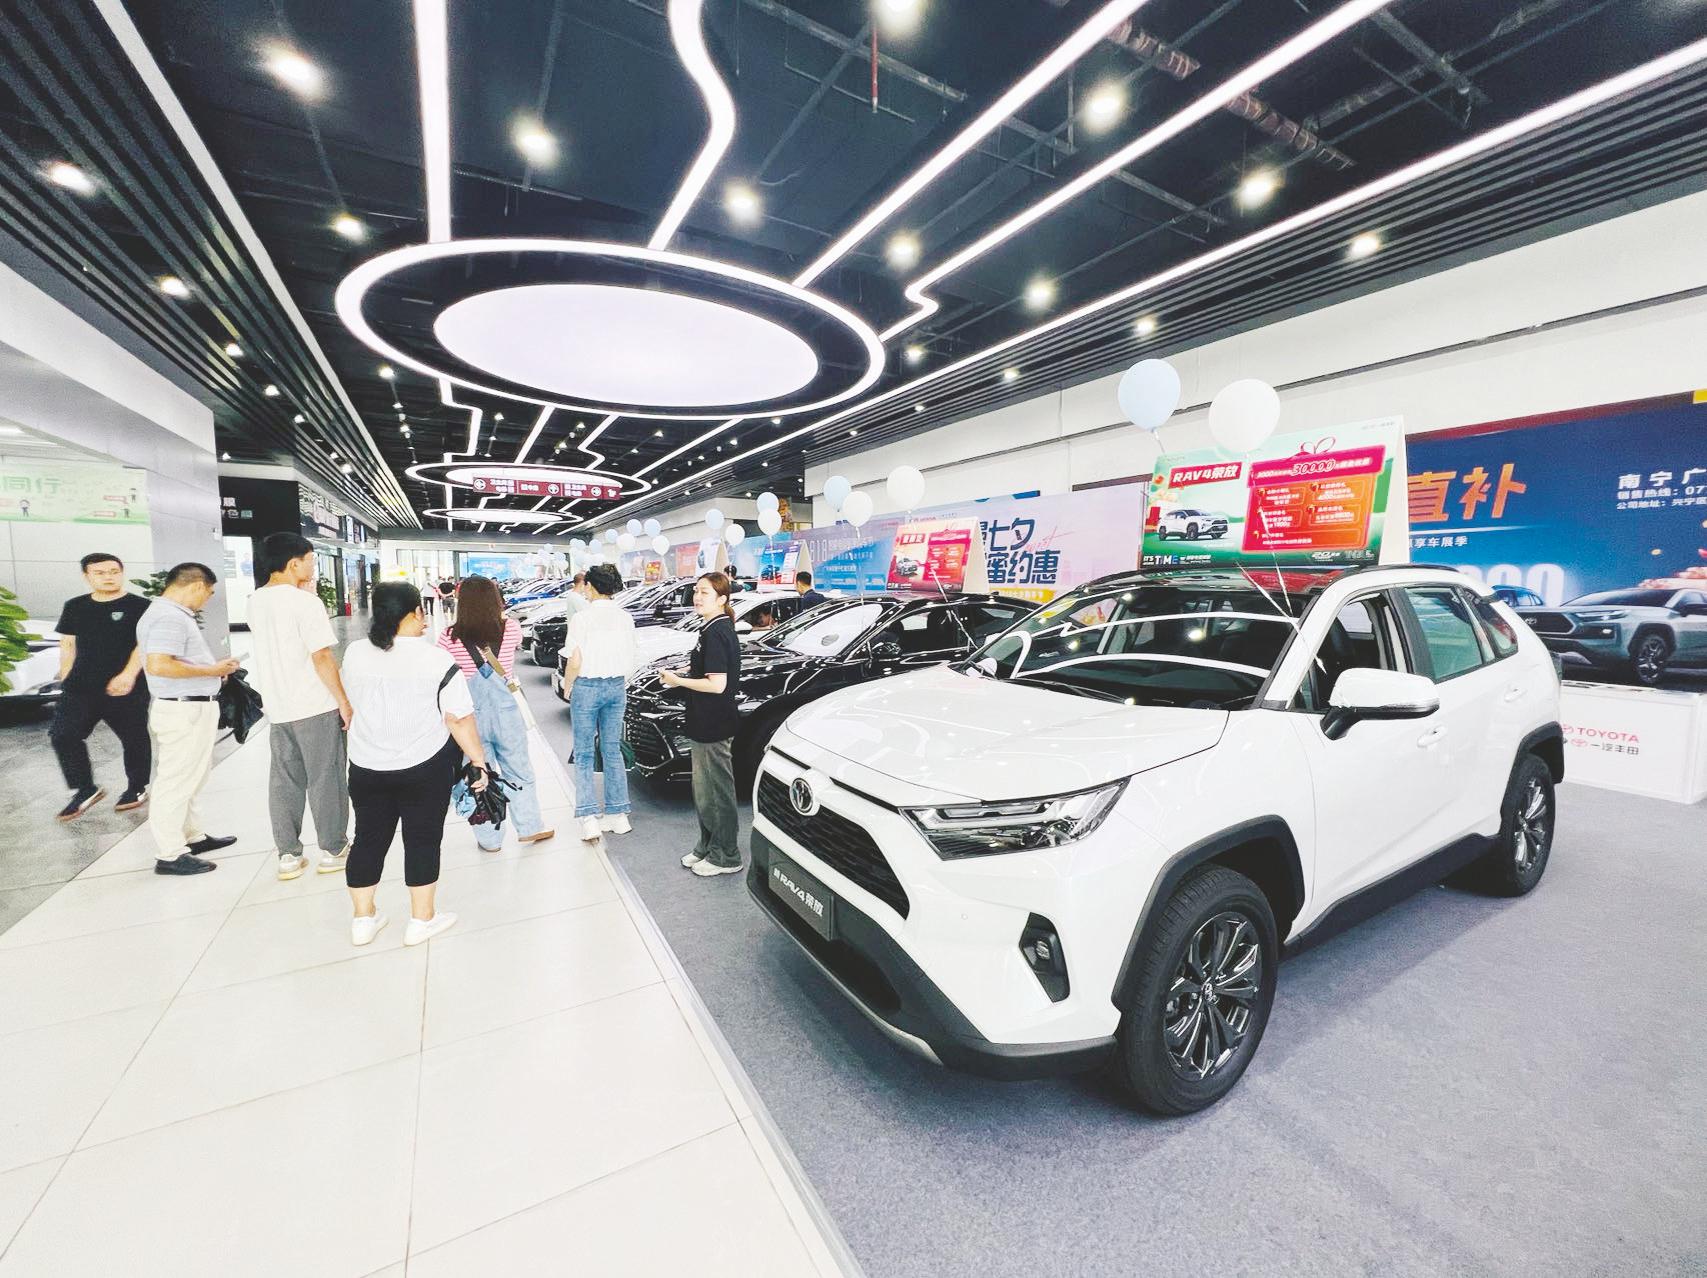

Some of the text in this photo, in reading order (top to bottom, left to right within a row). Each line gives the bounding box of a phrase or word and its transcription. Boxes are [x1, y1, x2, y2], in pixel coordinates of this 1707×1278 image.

[1172, 464, 1240, 484] RAV4荣放
[1407, 462, 1528, 524] 直补
[1408, 536, 1468, 550] 享车展季
[1577, 727, 1639, 743] TOYOTA
[1591, 742, 1639, 756] 一汽丰田
